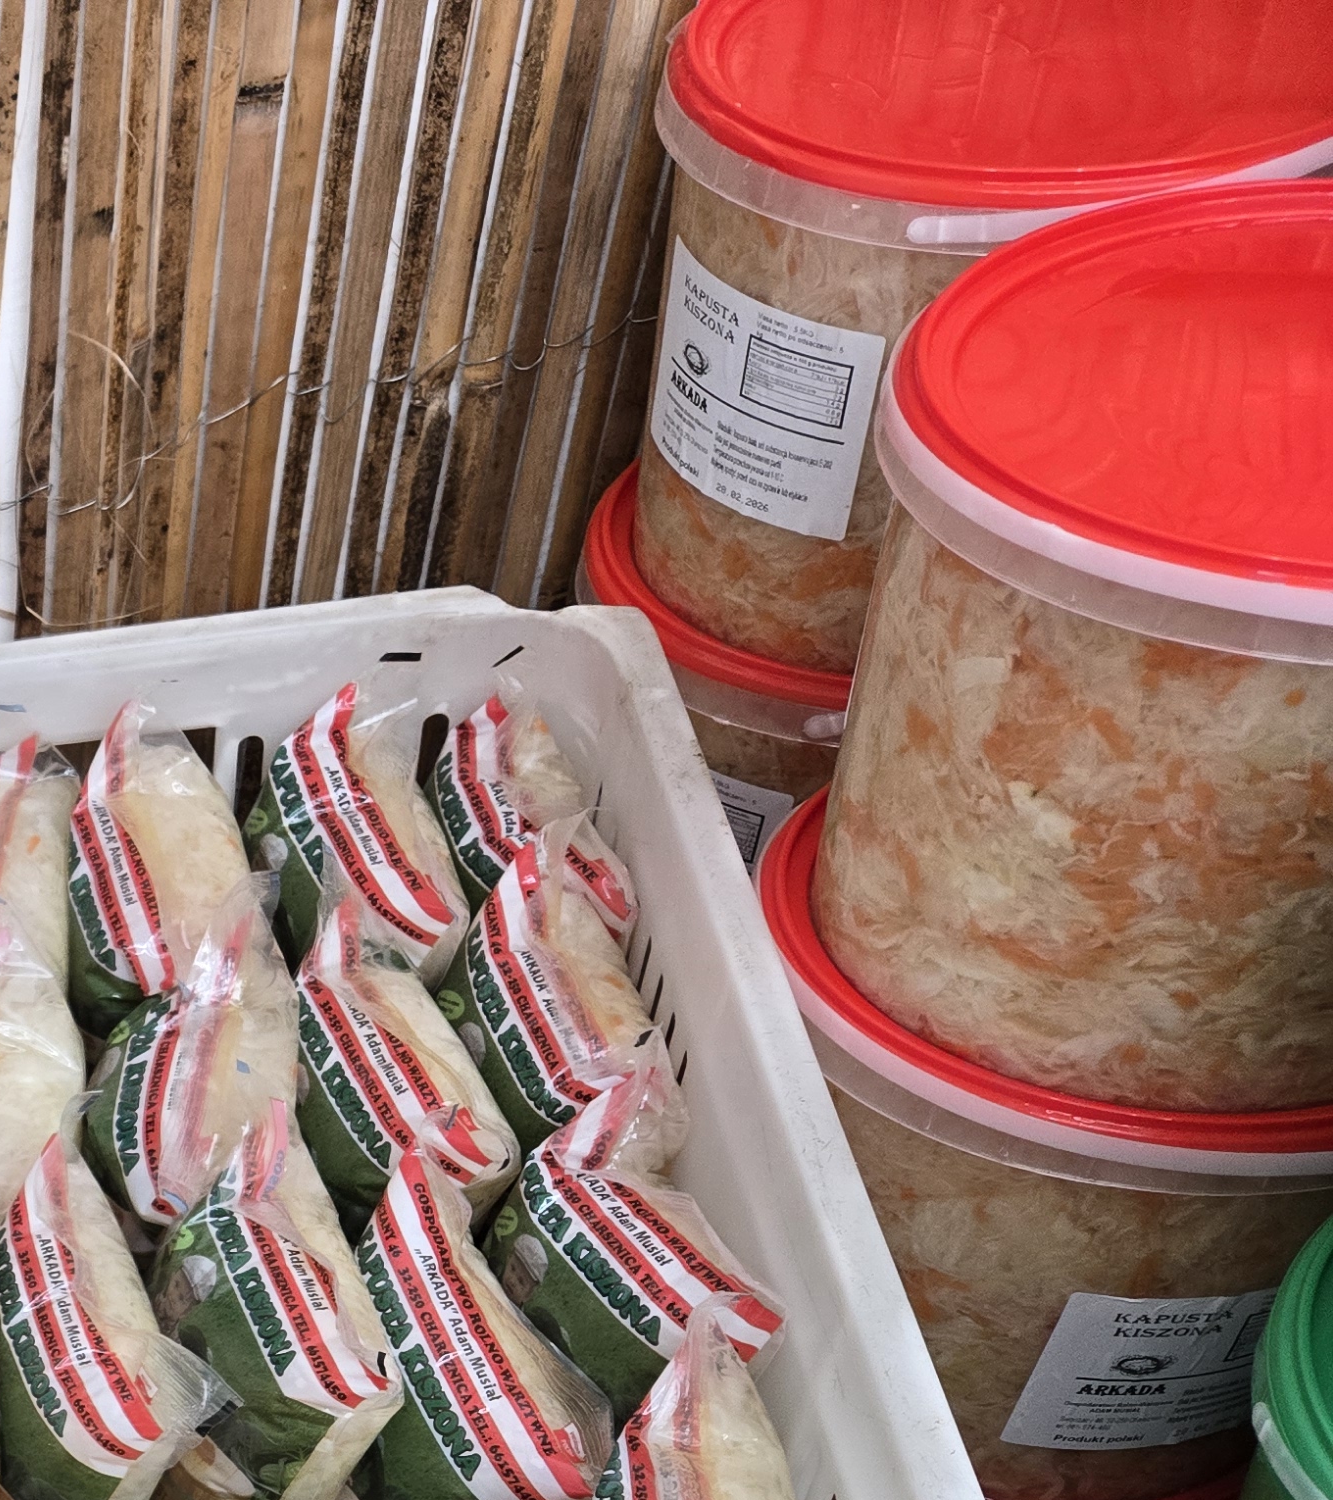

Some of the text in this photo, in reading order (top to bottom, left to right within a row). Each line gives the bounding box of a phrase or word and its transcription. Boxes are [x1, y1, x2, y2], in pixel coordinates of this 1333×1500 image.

[683, 295, 735, 344] KISZONA
[684, 274, 739, 327] KAPUSTA
[671, 370, 708, 414] ARKADA
[662, 436, 700, 477] Produkt polski
[109, 847, 135, 906] Adam Musiał
[360, 836, 382, 865] Musiał
[490, 941, 559, 1071] 46 32-250 CHARSZNICA
[145, 1041, 171, 1109] CHARSZNICA
[319, 1000, 383, 1103] 32-250 CHARSZNICA
[364, 1028, 408, 1096] Adam Musiał
[498, 1024, 577, 1124] KISZONA
[322, 1061, 391, 1169] KISZONA
[578, 1203, 641, 1277] CHARSZNICA
[607, 1202, 673, 1268] Adam Musiał
[288, 1249, 328, 1311] Adam Musiał
[563, 1231, 661, 1346] KISZONA
[66, 1324, 91, 1367] Musiał
[234, 1267, 297, 1377] KISZONA
[261, 1244, 299, 1312] CHARSZNICA
[306, 1344, 348, 1401] 661574450
[387, 1241, 402, 1257] 46
[398, 1266, 425, 1309] 32-250
[420, 1308, 471, 1406] CHARSZNICA
[413, 1183, 476, 1316] GOSPODARSTWO
[469, 1313, 557, 1457] ROLNO-WARZYWNE
[1113, 1325, 1222, 1338] KISZONA
[1114, 1310, 1233, 1324] KAPUSTA
[7, 1319, 68, 1438] KISZONA
[17, 1250, 38, 1288] 32-250
[73, 1398, 126, 1457] 661574450
[357, 1226, 482, 1482] KAPUSTA KISZONA
[448, 1314, 476, 1358] Adam
[470, 1358, 502, 1403] Musiał
[1076, 1384, 1166, 1396] ARKADA
[1053, 1434, 1146, 1443] Produkt polski
